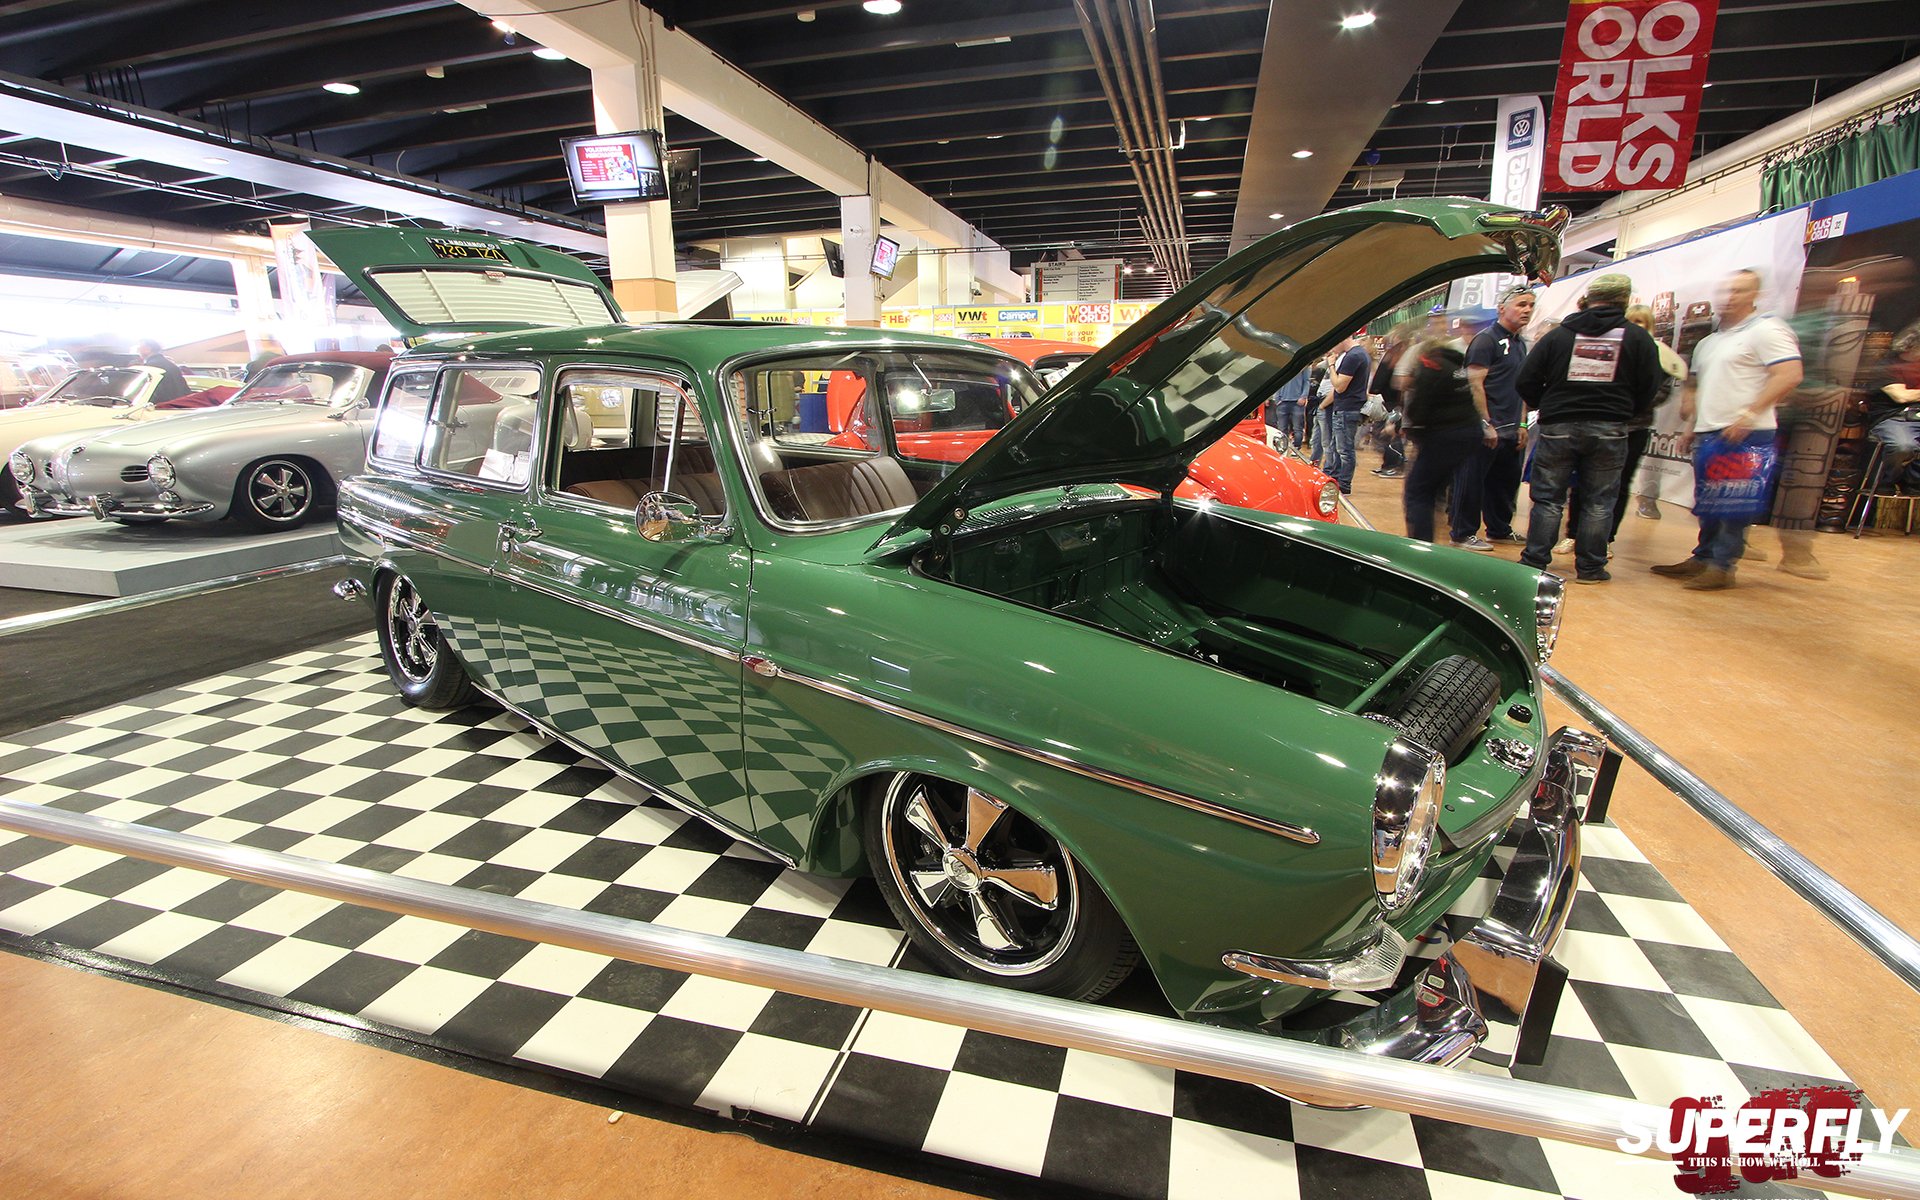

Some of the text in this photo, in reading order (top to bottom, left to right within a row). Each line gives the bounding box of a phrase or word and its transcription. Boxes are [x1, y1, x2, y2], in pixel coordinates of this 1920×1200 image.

[1069, 304, 1110, 315] VOLKS
[999, 311, 1037, 322] Camper
[1068, 314, 1110, 324] WORLD
[1498, 338, 1511, 356] 7
